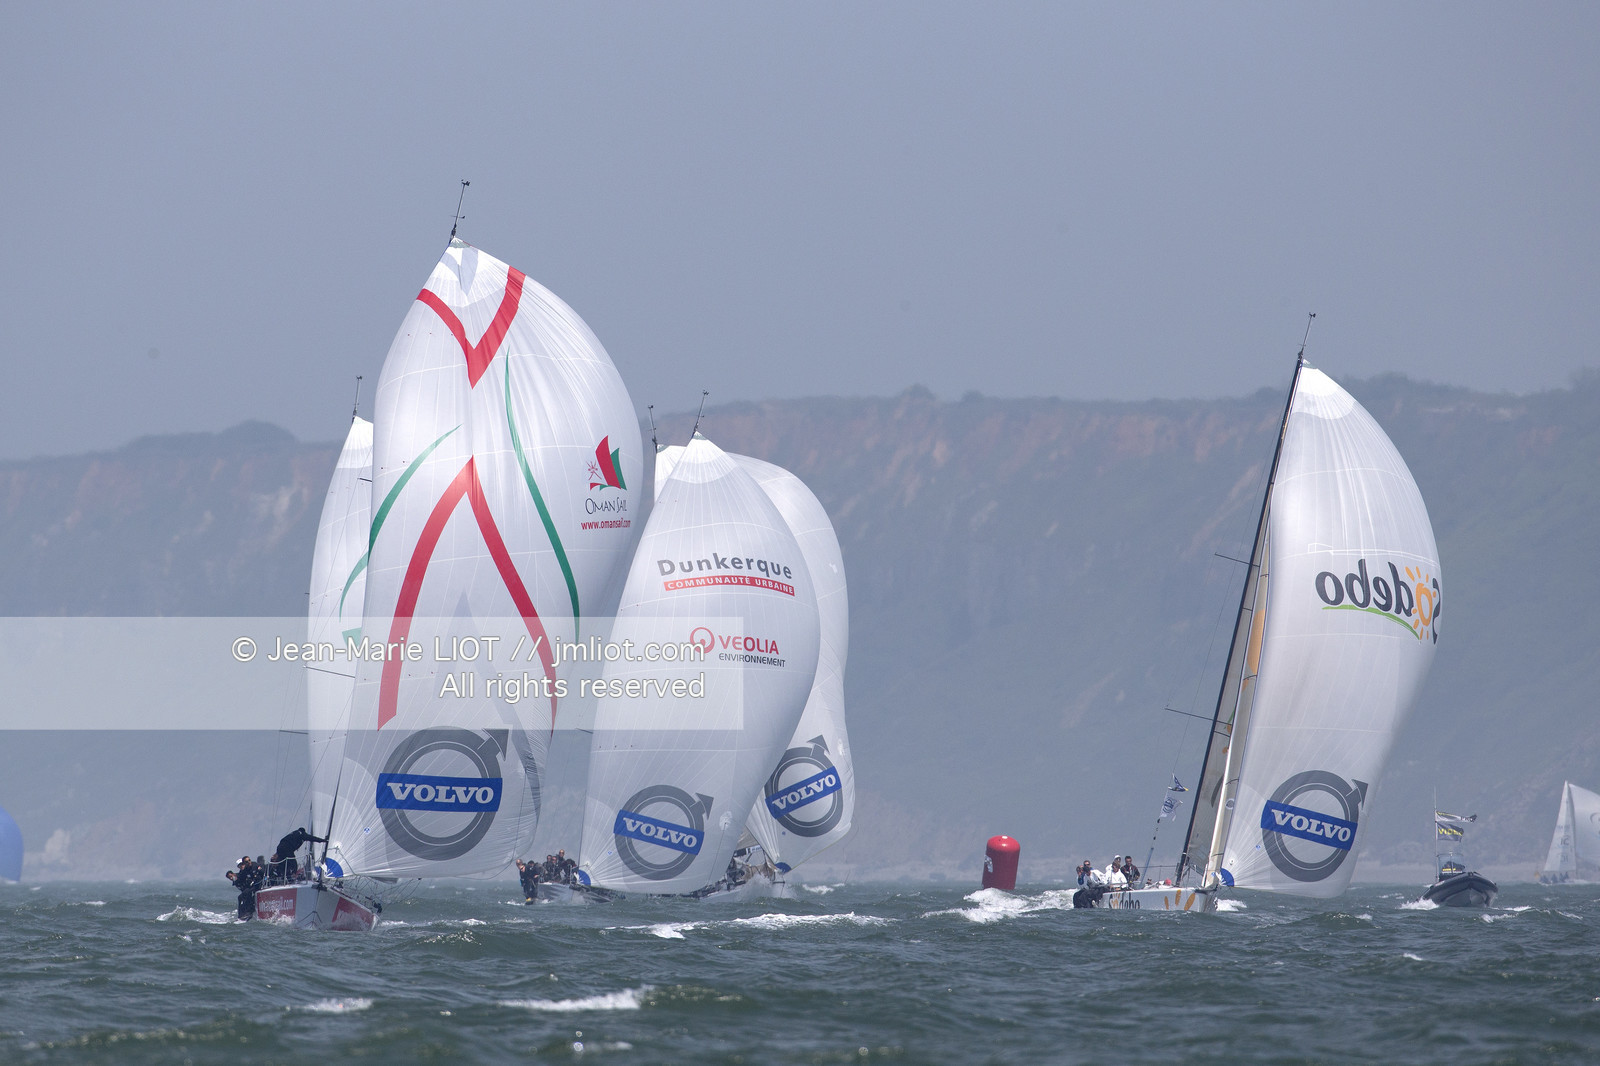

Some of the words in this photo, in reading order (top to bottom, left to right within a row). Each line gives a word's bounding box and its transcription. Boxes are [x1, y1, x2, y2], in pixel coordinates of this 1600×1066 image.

[657, 553, 793, 579] Dunkerque
[668, 576, 751, 589] COMMUNAUTÉ
[755, 578, 794, 595] URBAINE
[718, 635, 779, 655] VEOLIA
[719, 653, 785, 667] ENVIRONNEMENT
[386, 782, 494, 804] VOLVO
[772, 773, 836, 811] VOLVO
[622, 817, 698, 848] VOLVO
[1271, 809, 1351, 842] VOLVO
